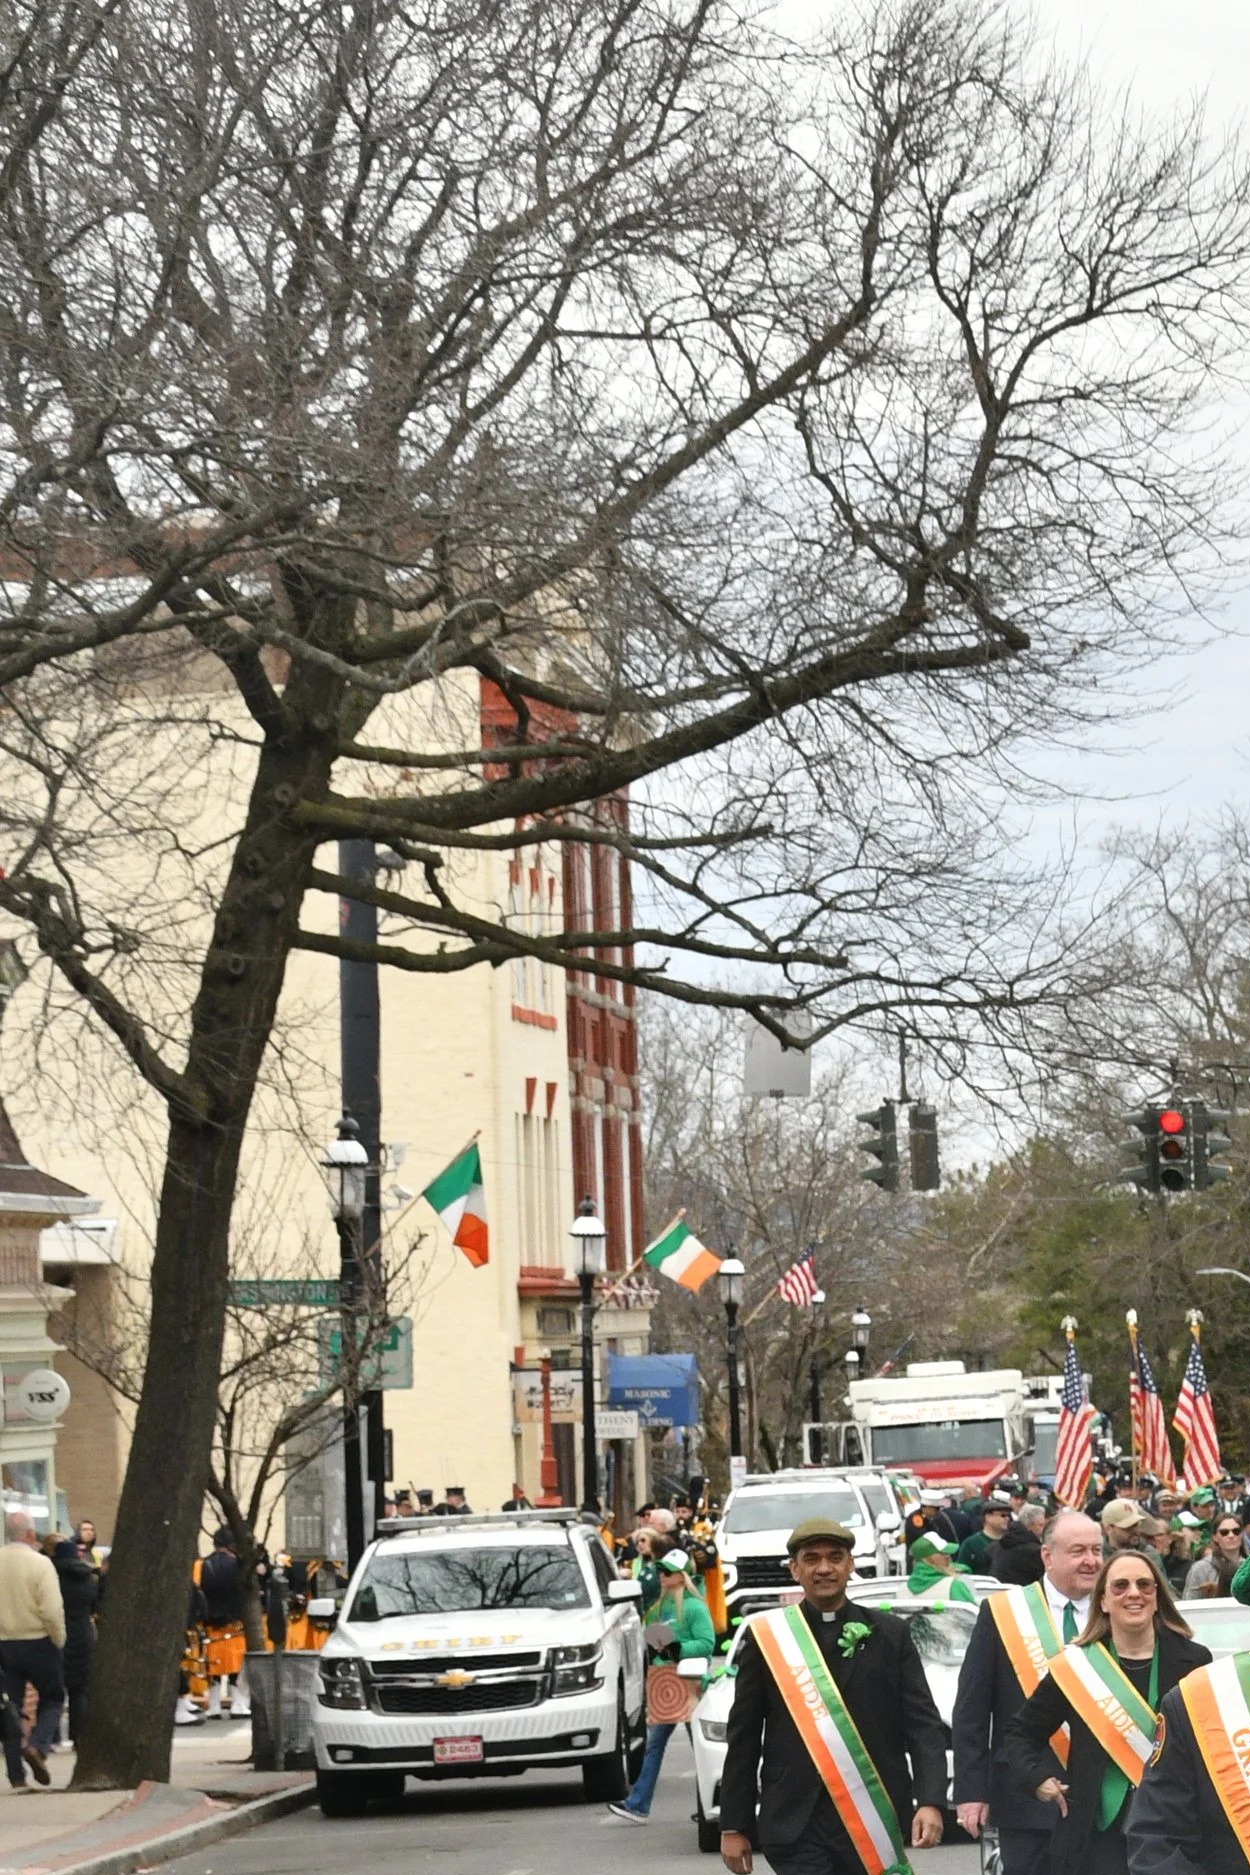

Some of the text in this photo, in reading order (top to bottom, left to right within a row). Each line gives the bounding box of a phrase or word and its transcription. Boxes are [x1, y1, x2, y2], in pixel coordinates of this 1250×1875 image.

[624, 1389, 671, 1399] MASONIC
[1021, 1635, 1047, 1676] AIDE
[790, 1664, 828, 1721] AIDE
[1095, 1696, 1137, 1742] AIDE
